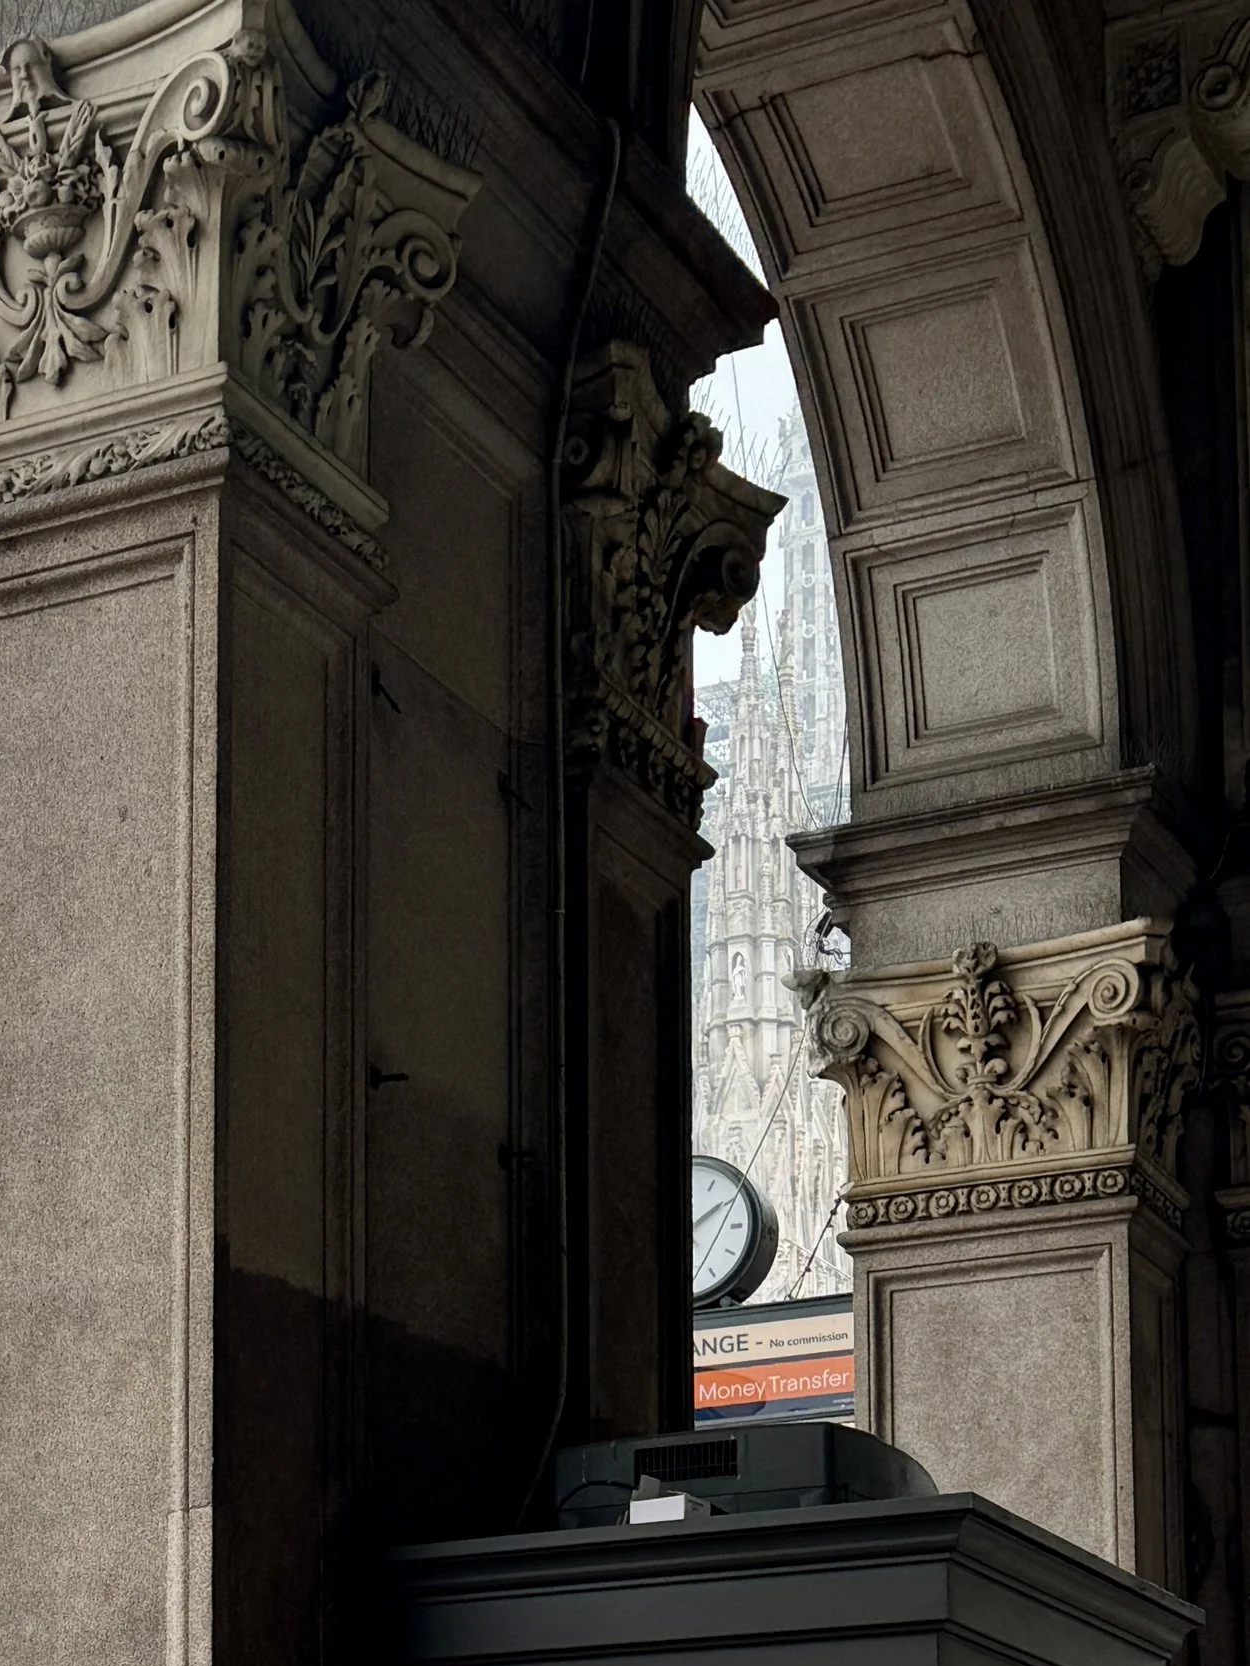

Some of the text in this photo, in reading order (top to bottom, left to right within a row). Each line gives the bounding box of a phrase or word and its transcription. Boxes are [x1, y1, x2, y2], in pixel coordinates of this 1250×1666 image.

[769, 1338, 784, 1348] No
[787, 1331, 849, 1346] commission
[699, 1368, 850, 1402] Money Transfer
